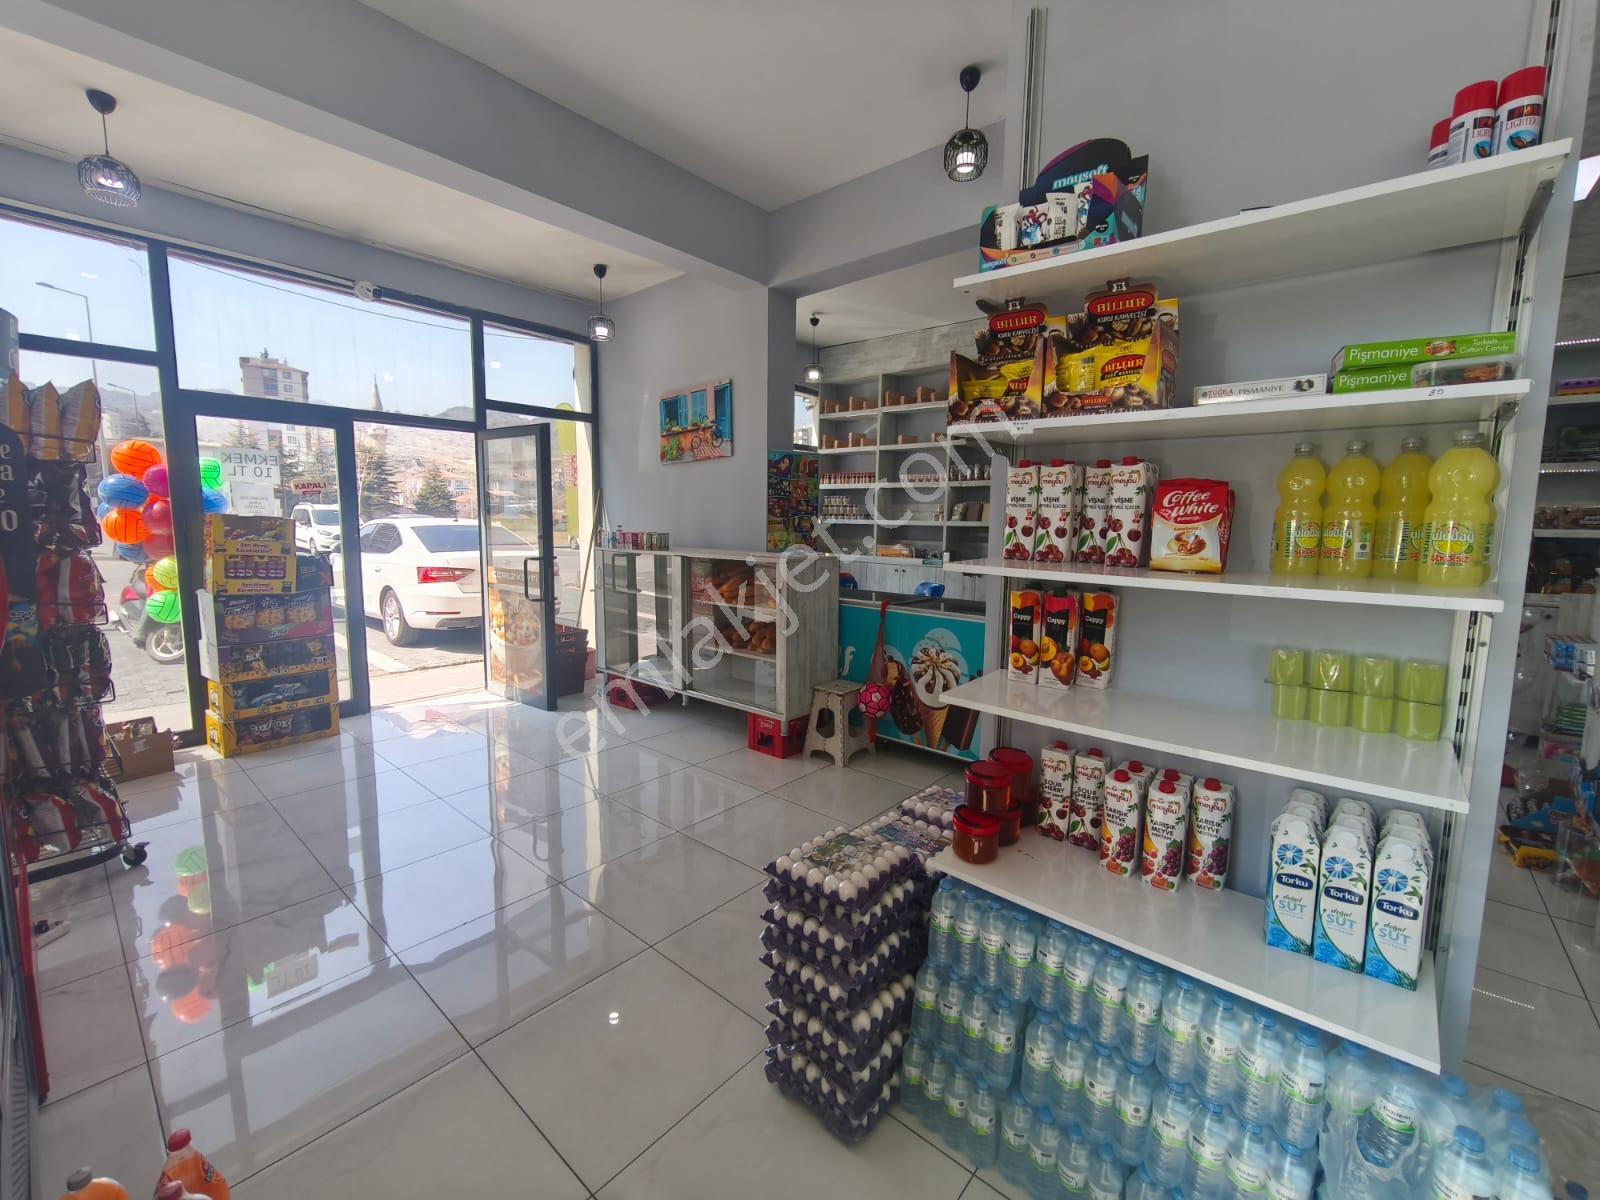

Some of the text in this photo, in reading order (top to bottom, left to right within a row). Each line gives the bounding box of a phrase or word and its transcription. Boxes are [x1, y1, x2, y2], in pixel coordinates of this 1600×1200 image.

[1349, 344, 1419, 362] Pişmaniye
[1338, 371, 1407, 389] Pişmaniye
[1162, 490, 1211, 508] Coffee
[1171, 502, 1220, 518] White
[1280, 875, 1309, 889] Torku
[1329, 888, 1360, 903] Torku
[1382, 901, 1414, 918] Torku
